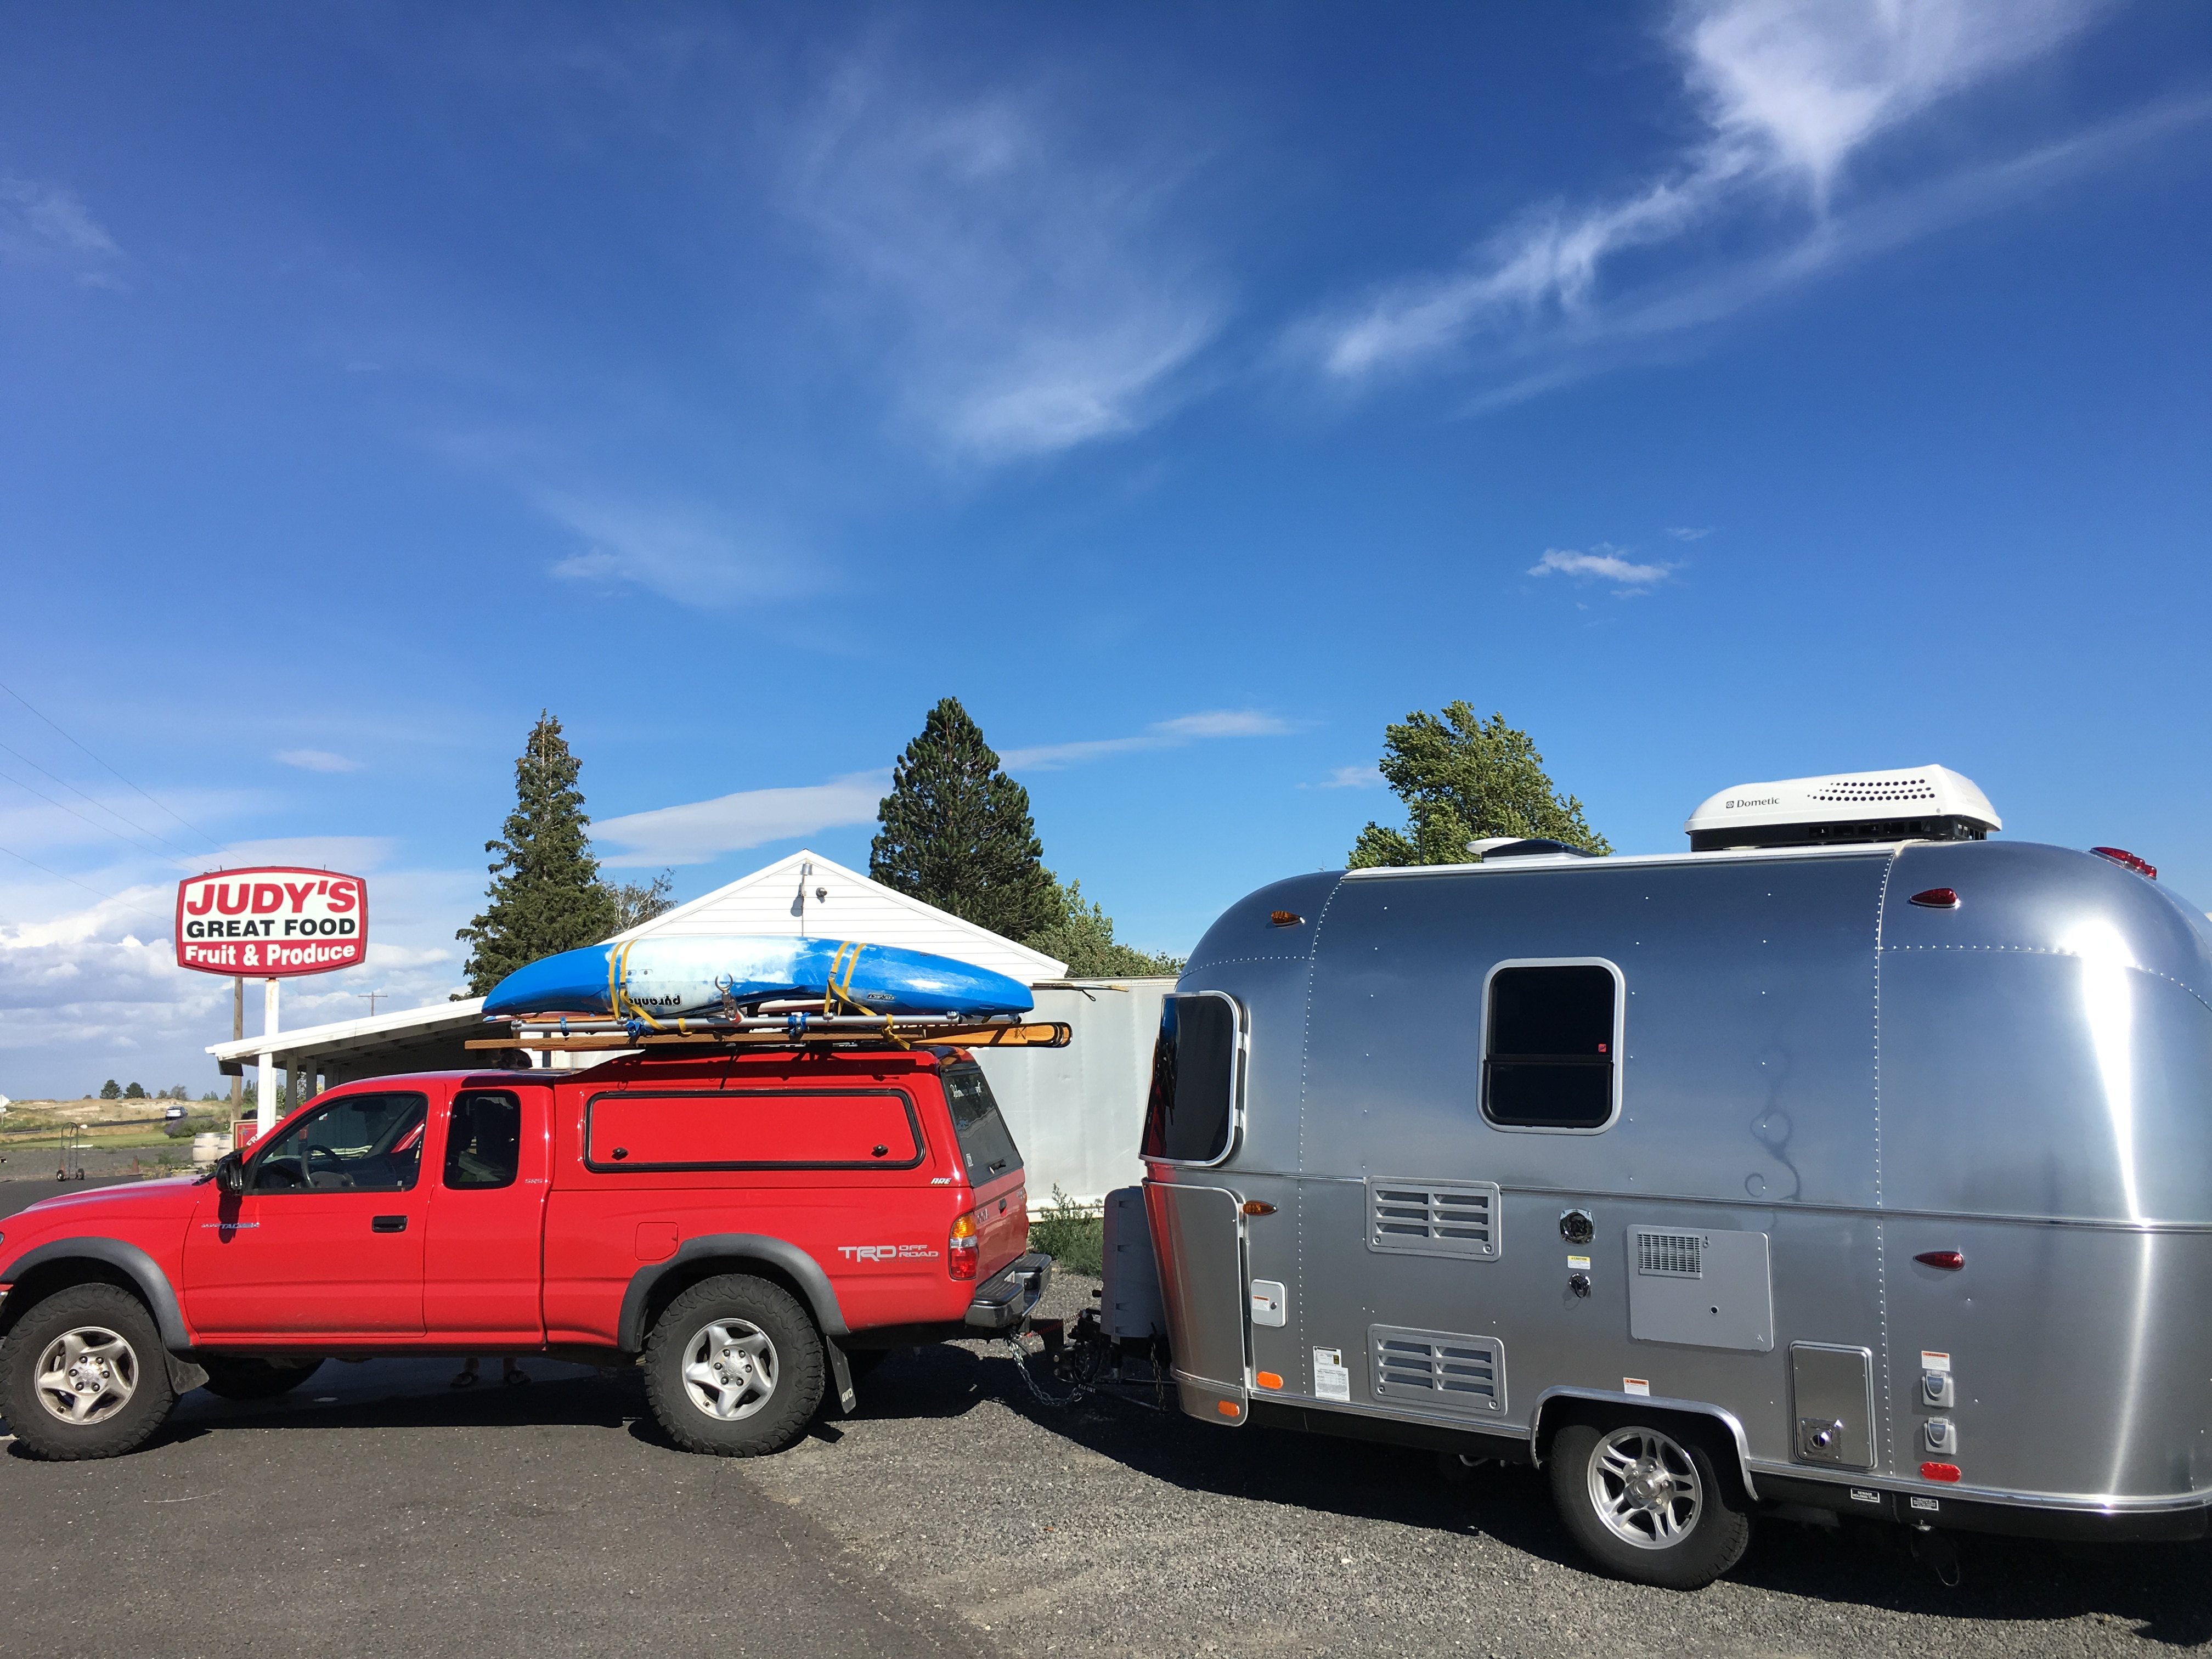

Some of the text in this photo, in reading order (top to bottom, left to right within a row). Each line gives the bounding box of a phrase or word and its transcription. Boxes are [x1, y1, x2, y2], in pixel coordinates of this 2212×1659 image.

[1737, 797, 1780, 808] Dometic
[187, 880, 357, 916] JUDY'S
[187, 918, 356, 938] GREAT FOOD
[185, 943, 356, 966] Fruit & Produce
[838, 1245, 896, 1262] TRD
[842, 1387, 853, 1402] 4WD
